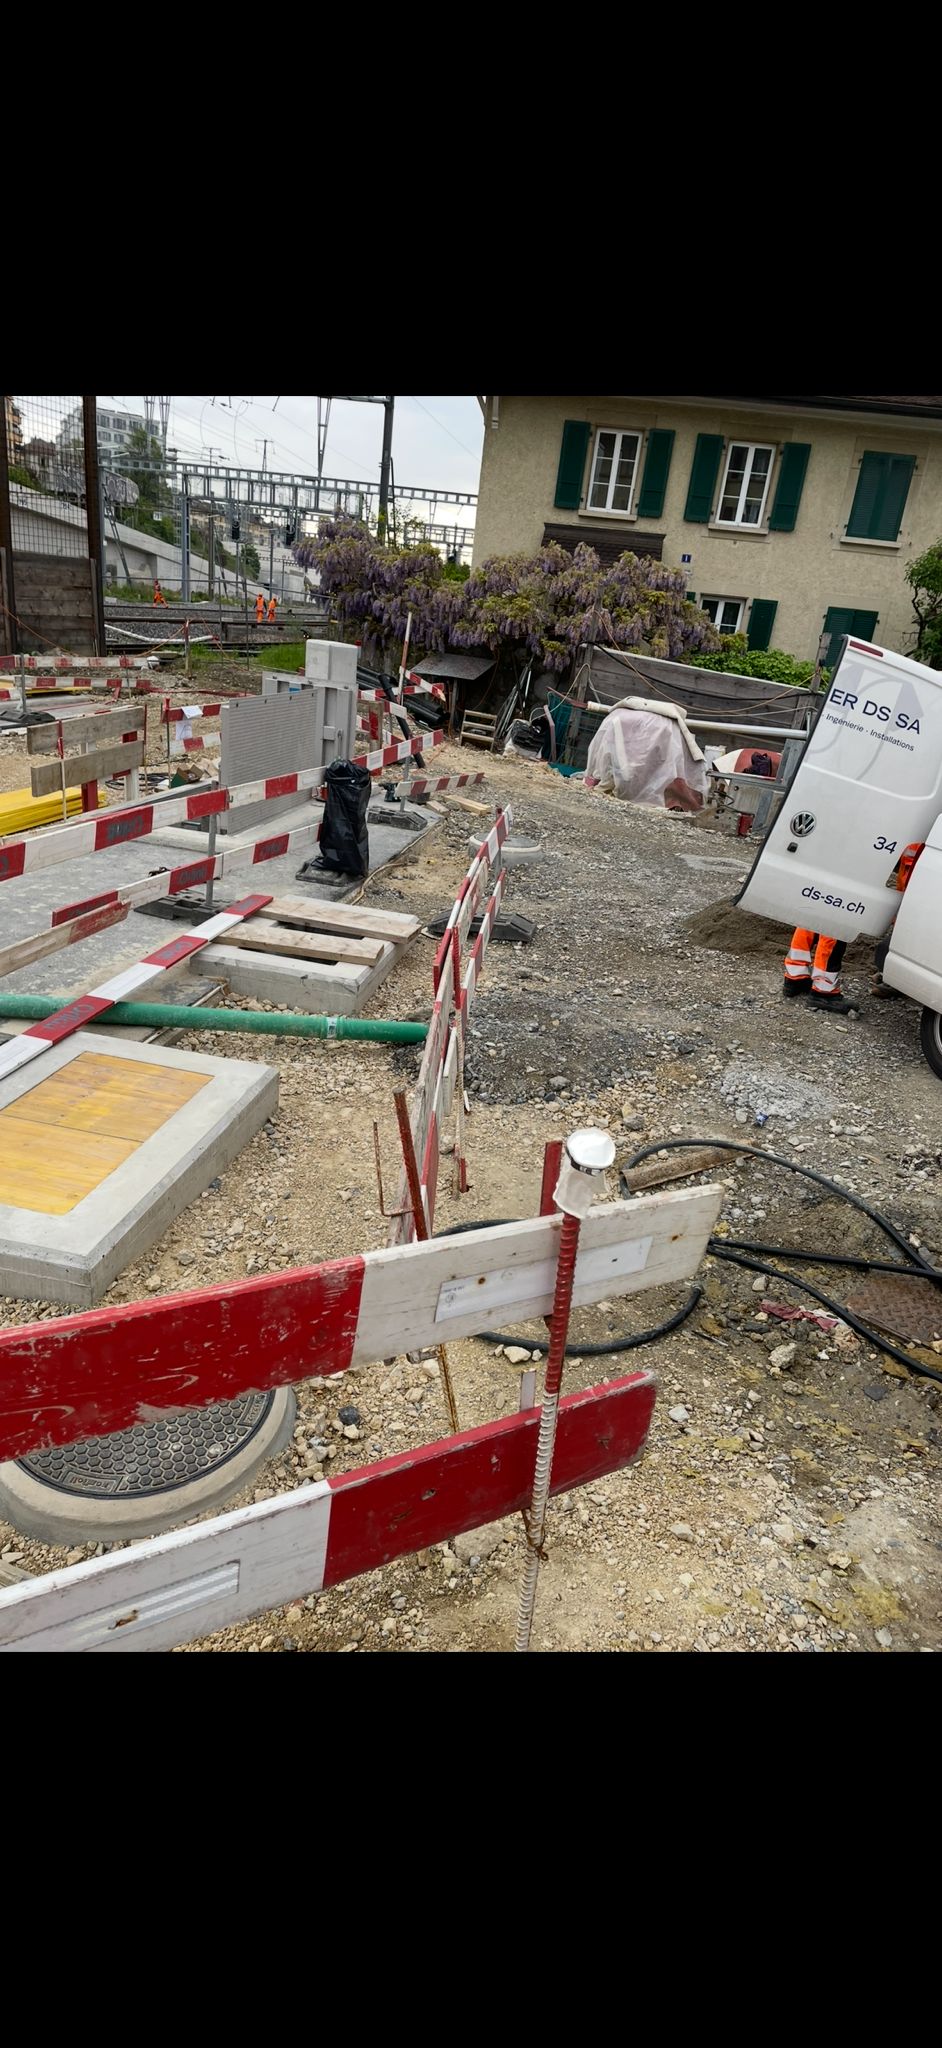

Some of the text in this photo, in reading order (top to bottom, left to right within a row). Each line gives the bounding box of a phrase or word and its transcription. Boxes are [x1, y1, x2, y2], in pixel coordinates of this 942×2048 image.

[829, 688, 920, 735] ER DS SA
[870, 729, 915, 751] Installations
[873, 836, 898, 855] 34
[801, 886, 866, 915] ds-sa.ch
